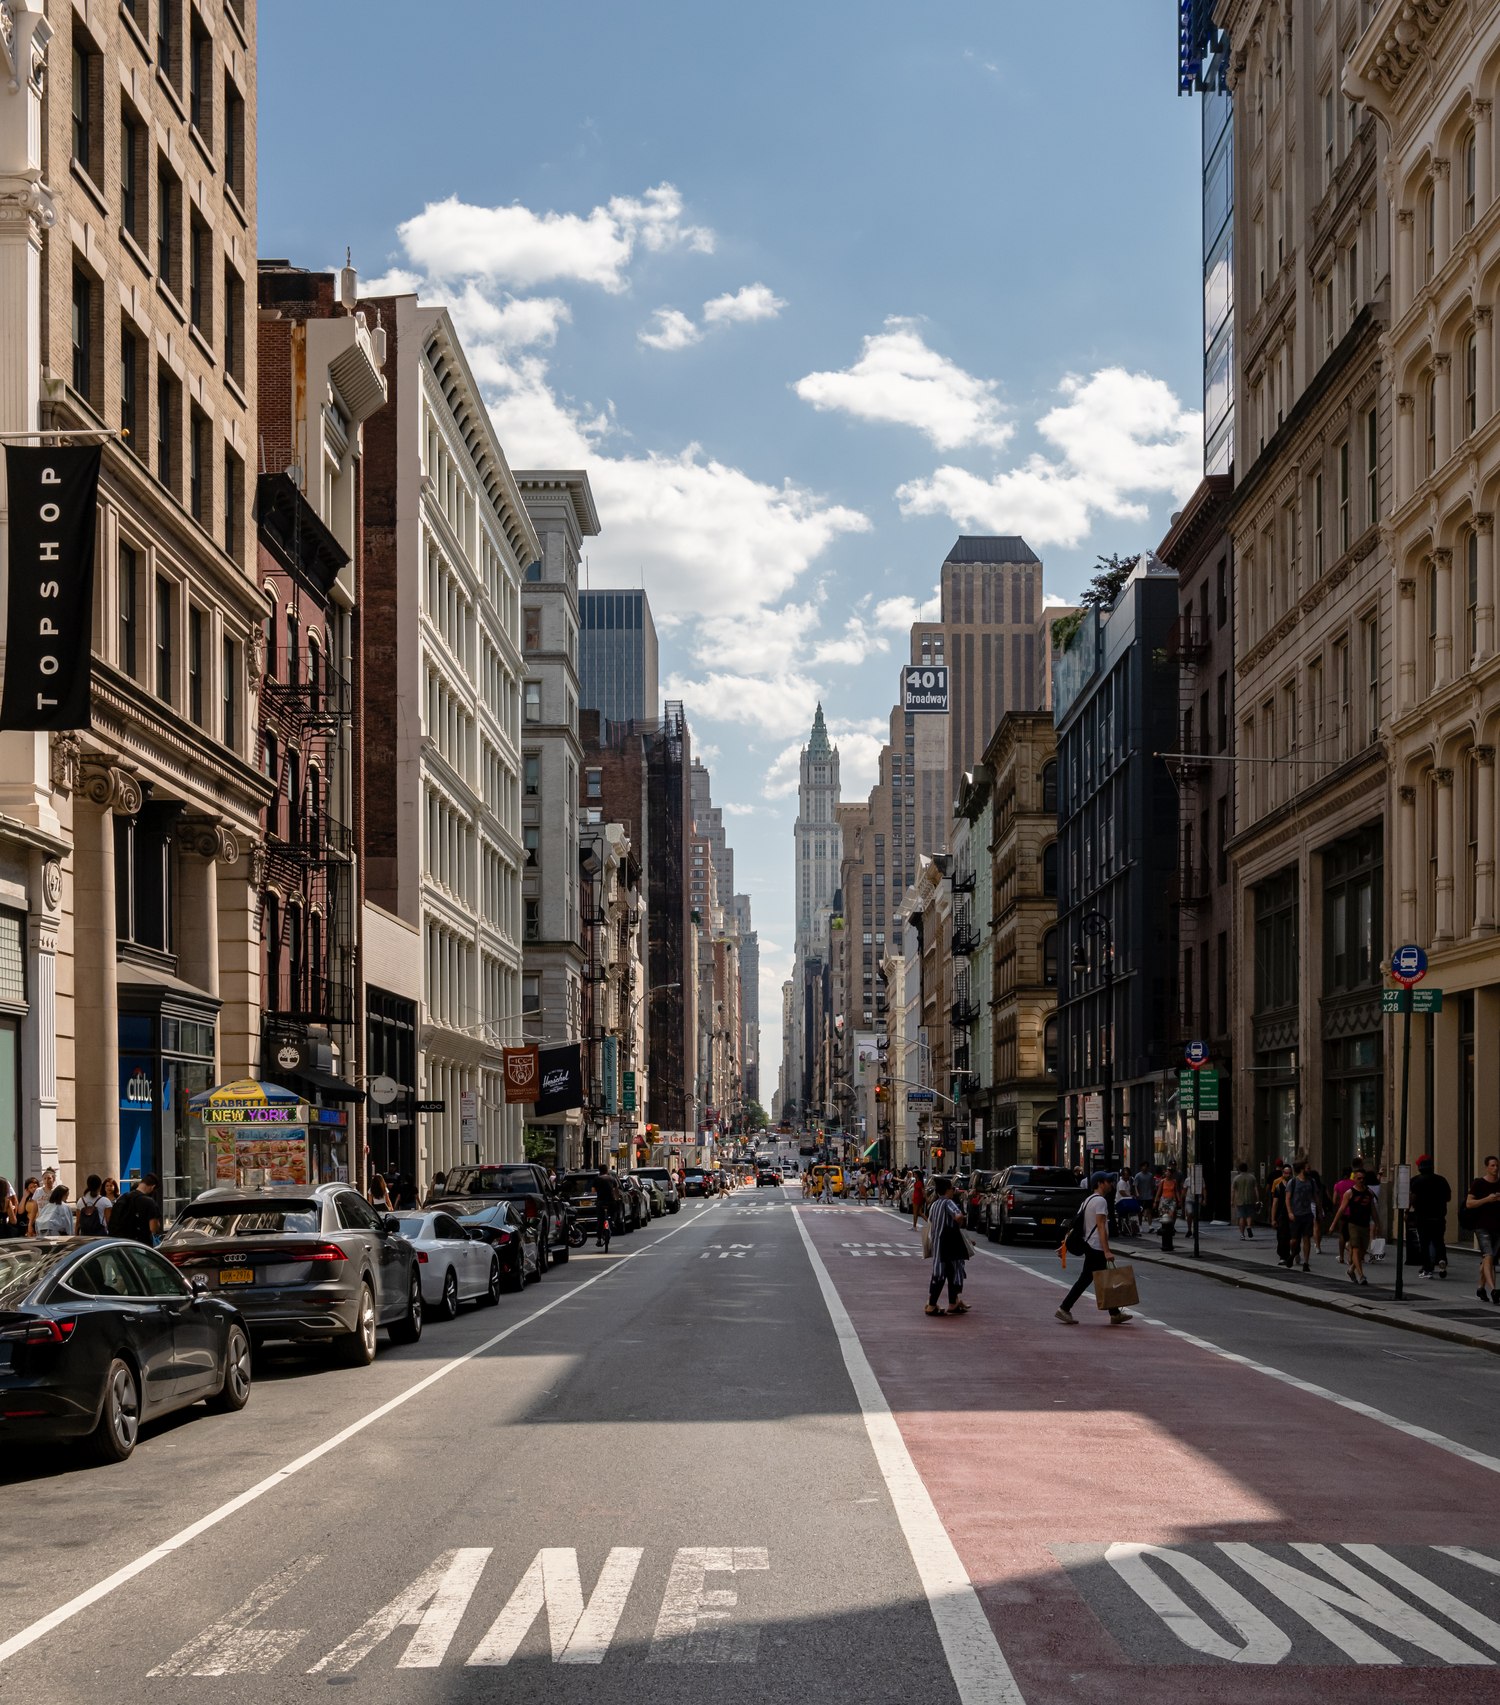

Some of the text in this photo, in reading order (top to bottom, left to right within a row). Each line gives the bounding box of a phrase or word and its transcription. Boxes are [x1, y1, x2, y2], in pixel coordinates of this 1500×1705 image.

[37, 467, 62, 710] TOPSHOP
[906, 671, 944, 688] 401
[906, 691, 947, 707] Broadway
[1401, 971, 1424, 982] STANDING
[1383, 991, 1399, 1000] x27
[1382, 1003, 1399, 1012] x28
[542, 1069, 570, 1088] Herschel
[212, 1098, 263, 1107] SABRETT
[212, 1109, 289, 1122] NEW YORK
[670, 1135, 696, 1143] Locer
[145, 1547, 770, 1678] LANE
